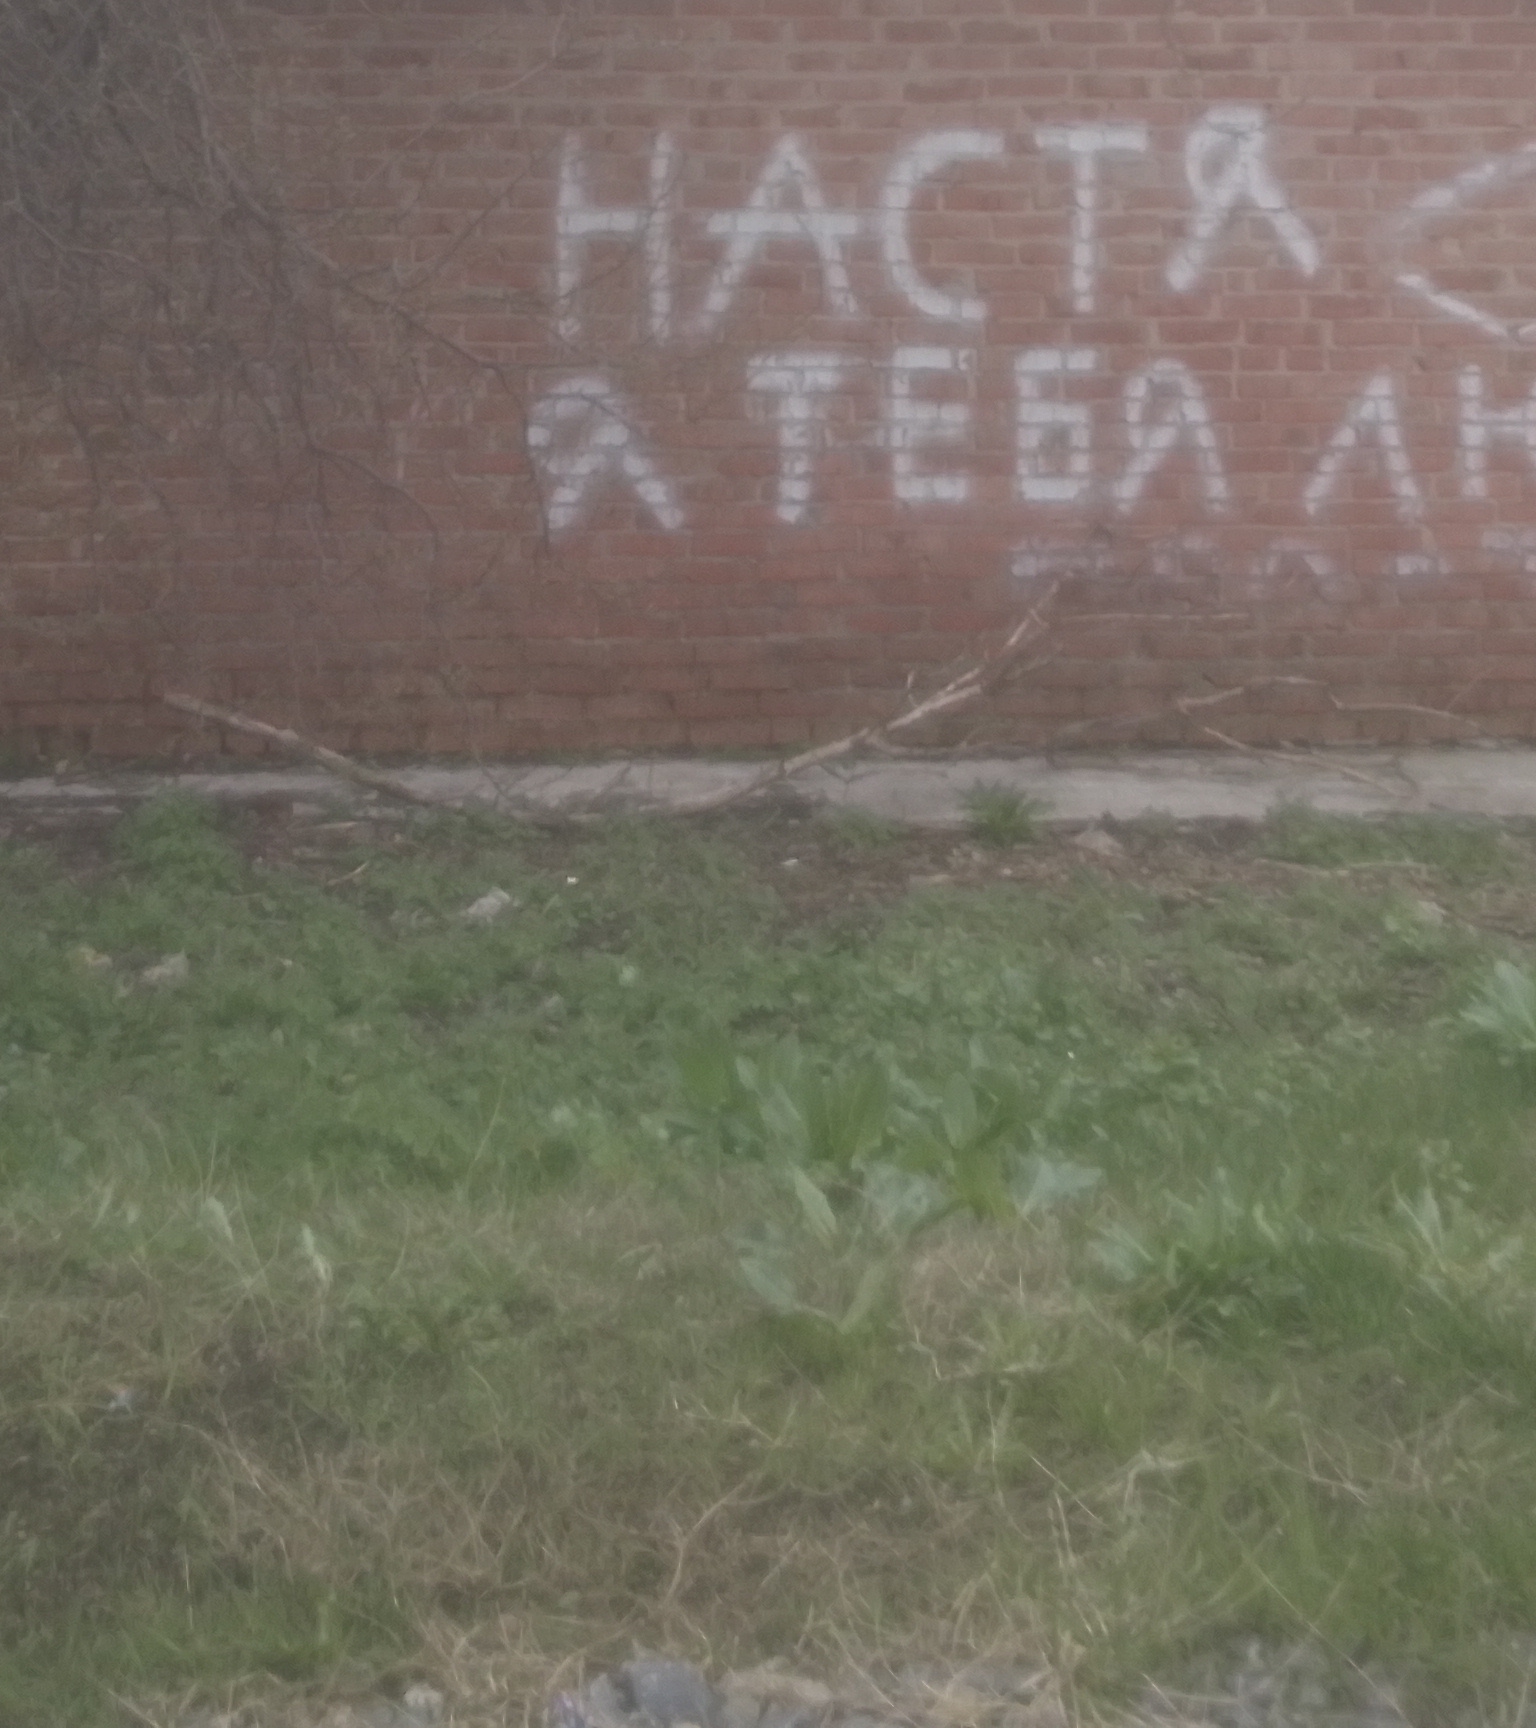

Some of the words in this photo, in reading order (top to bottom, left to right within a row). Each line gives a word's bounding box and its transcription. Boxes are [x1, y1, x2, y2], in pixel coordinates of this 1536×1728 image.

[552, 104, 1326, 342] НАСТЯ
[526, 372, 686, 534] Я
[744, 344, 1232, 524] ТЕБЯ
